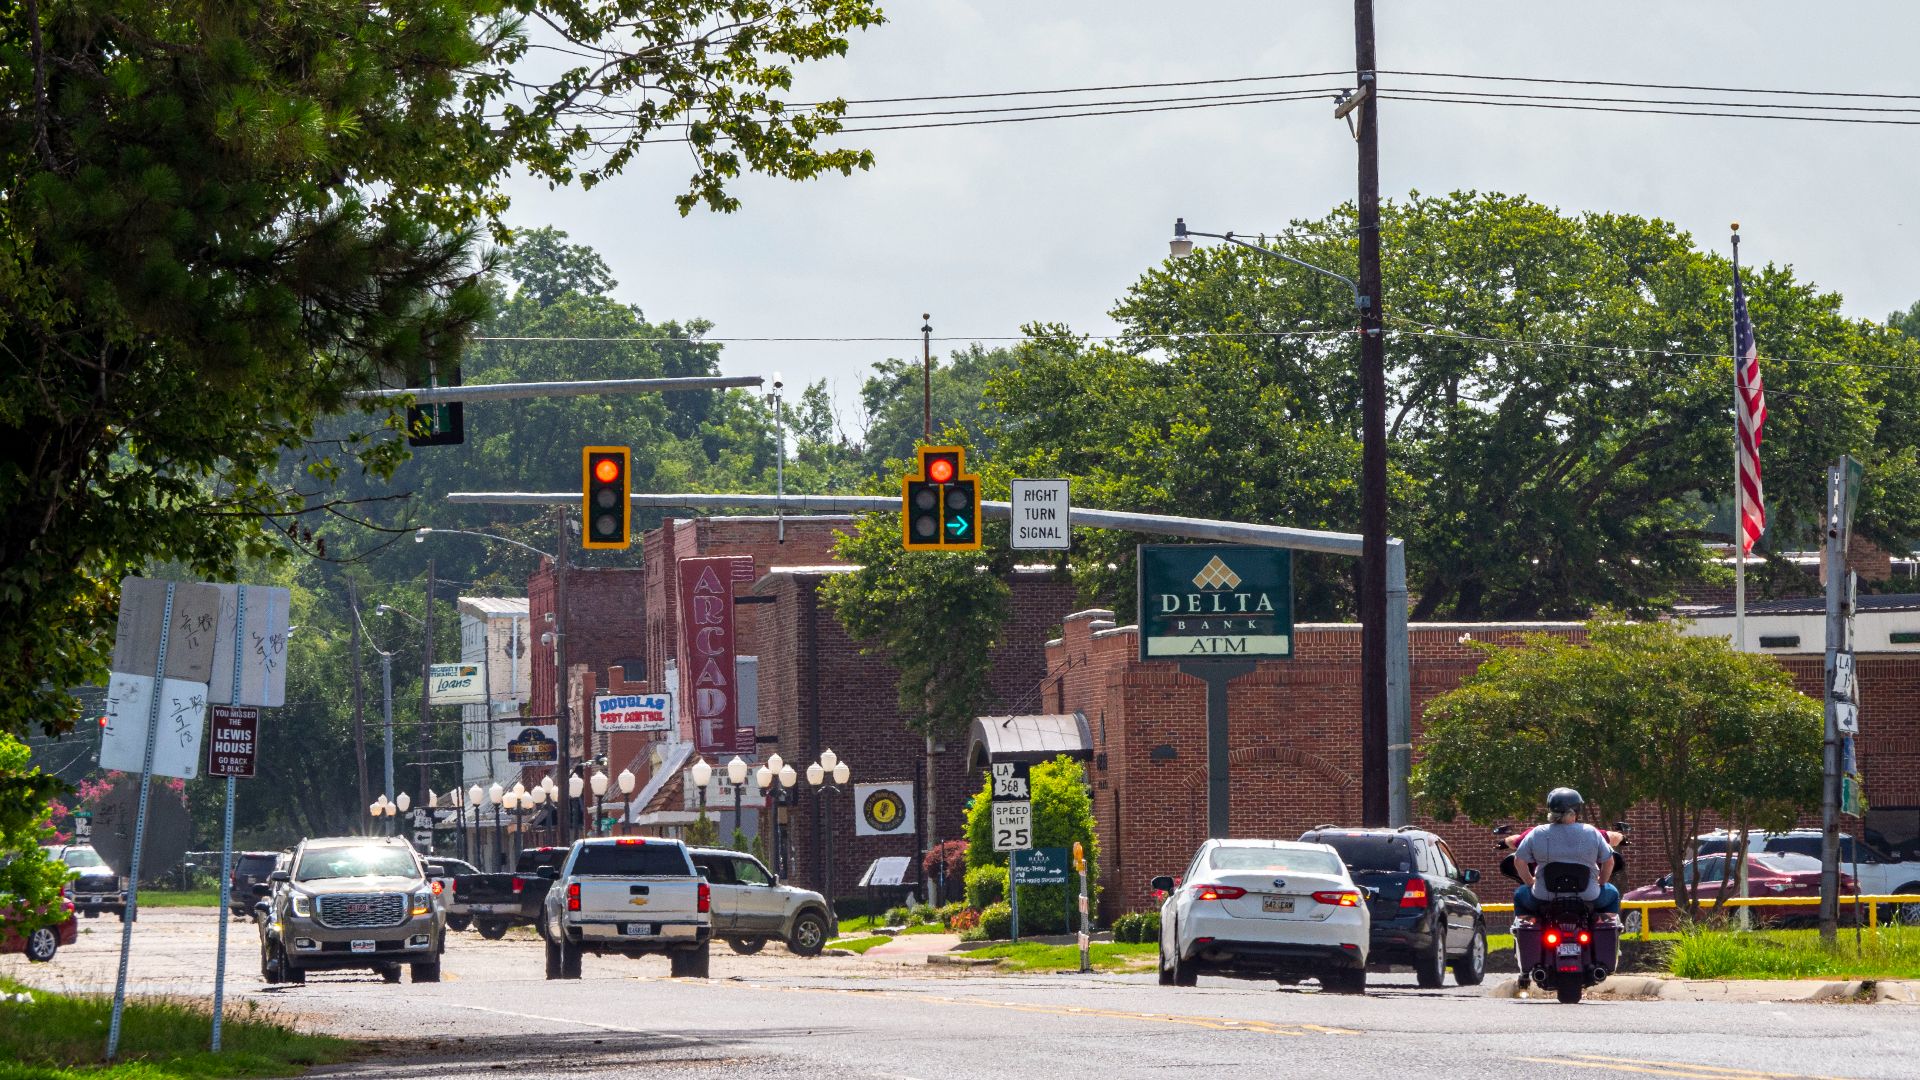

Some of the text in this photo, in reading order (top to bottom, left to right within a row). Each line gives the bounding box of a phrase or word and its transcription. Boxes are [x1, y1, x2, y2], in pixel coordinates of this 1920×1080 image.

[1024, 489, 1059, 502] RIGHT
[1025, 508, 1056, 520] TURN
[1020, 526, 1062, 539] SIGNAL
[1161, 593, 1274, 613] DELTA
[1178, 620, 1257, 630] BANK
[1189, 637, 1248, 653] ATM
[693, 565, 727, 747] ARCADE
[436, 678, 472, 693] Loans
[599, 696, 665, 713] DOUGLAS
[215, 709, 257, 719] YOU MISSED
[600, 711, 665, 724] PEST CONTROL
[229, 718, 242, 726] THE
[217, 728, 252, 741] LEWIS
[215, 741, 253, 754] HOUSE
[218, 756, 248, 765] GO BACK
[220, 764, 226, 772] 3
[997, 764, 1009, 776] LA
[1001, 779, 1019, 793] 568
[996, 806, 1028, 816] SPEED
[1000, 816, 1025, 825] LIMIT
[998, 828, 1028, 847] 25
